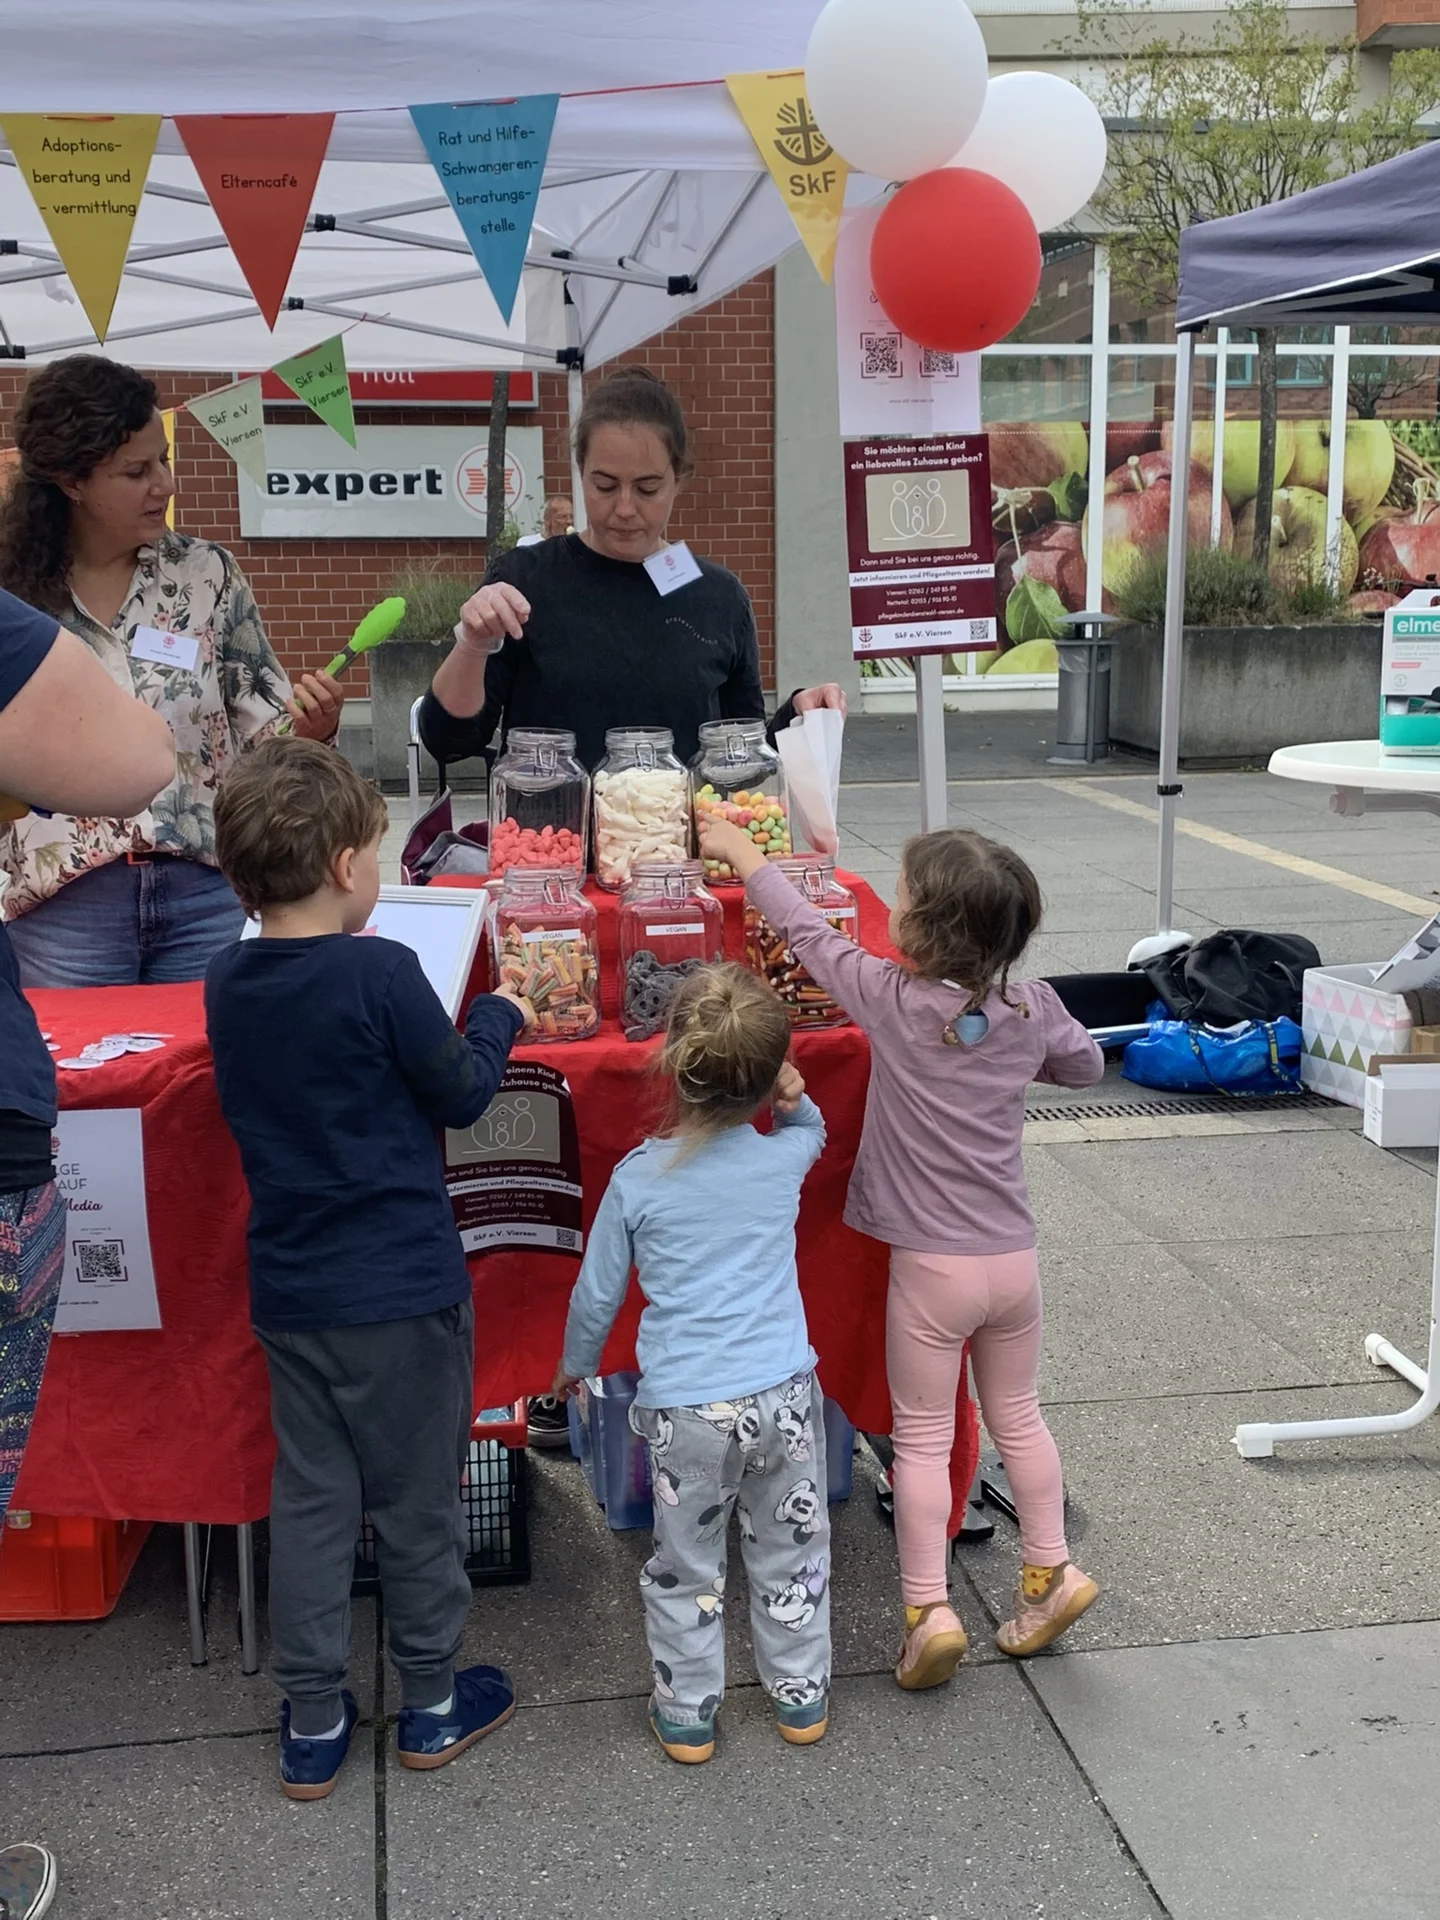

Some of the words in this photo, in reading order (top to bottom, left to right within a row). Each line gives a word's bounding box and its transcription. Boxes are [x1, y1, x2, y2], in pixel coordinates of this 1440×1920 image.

[438, 131, 462, 146] Rat
[468, 128, 492, 144] und
[496, 125, 535, 140] Hilfe-
[41, 137, 122, 155] Adoptions-
[442, 159, 539, 177] Schwangeren-
[32, 169, 100, 186] beratung
[106, 169, 131, 183] und
[221, 174, 298, 189] Elterncafé
[789, 170, 836, 196] SkF
[456, 190, 532, 206] beratungs-
[52, 200, 137, 217] vermittlung
[480, 217, 516, 234] stelle
[295, 370, 314, 389] SkF
[318, 362, 337, 379] e.V.
[308, 384, 349, 408] Viersen
[208, 410, 228, 428] SkF
[233, 403, 252, 419] e.V.
[220, 426, 263, 447] Viersen
[864, 446, 878, 455] Sie
[880, 444, 917, 454] möchten
[918, 443, 944, 452] einem
[945, 440, 966, 450] Kind
[851, 461, 864, 470] ein
[865, 458, 912, 469] liebevolles
[913, 456, 949, 466] Zuhause
[951, 452, 983, 466] geben?
[266, 468, 443, 500] expert
[860, 558, 878, 566] Dann
[880, 556, 894, 565] sind
[895, 556, 906, 564] Sie
[907, 555, 919, 563] bei
[933, 555, 954, 563] genau
[925, 629, 952, 637] Viersen
[505, 1066, 536, 1074] einem
[537, 1067, 556, 1080] Kind
[500, 1078, 540, 1087] Zuhause
[56, 1163, 80, 1175] GE
[458, 1167, 474, 1176] sind
[475, 1166, 488, 1174] Sie
[58, 1178, 87, 1190] AUF
